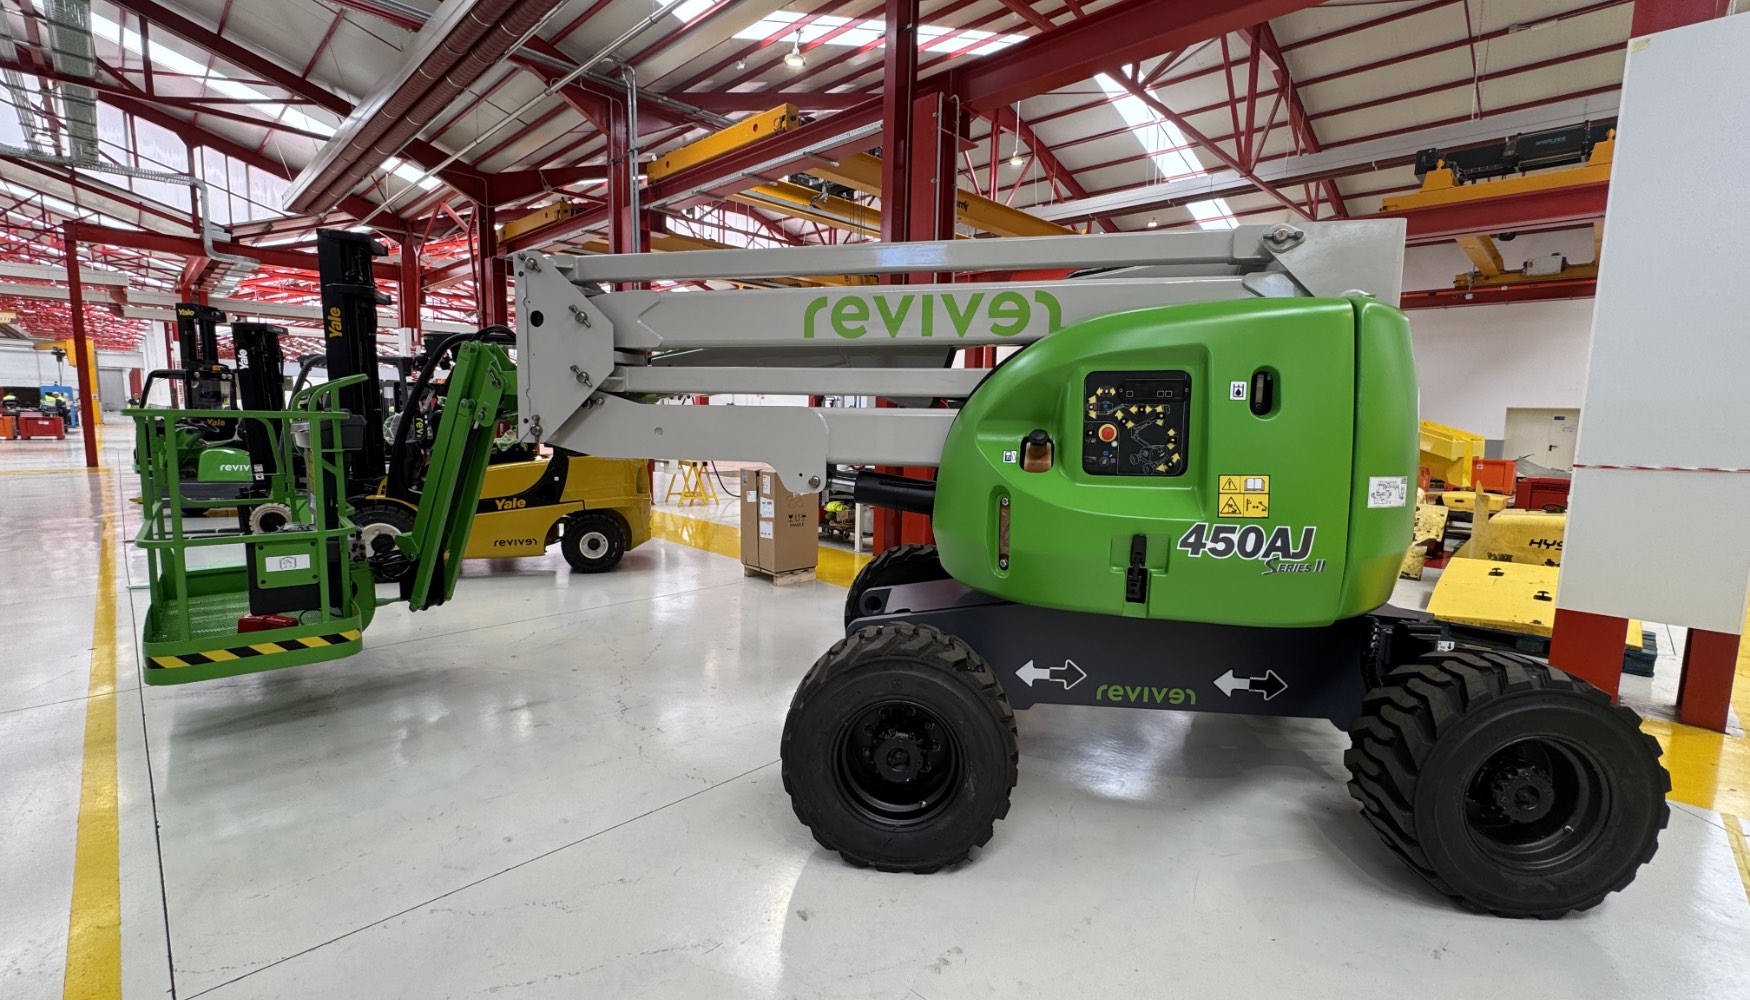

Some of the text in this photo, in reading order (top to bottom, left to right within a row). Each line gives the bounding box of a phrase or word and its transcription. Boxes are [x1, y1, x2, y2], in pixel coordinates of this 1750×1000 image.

[178, 308, 195, 316] Yale
[803, 289, 1064, 339] reviver
[327, 306, 342, 338] Yale
[238, 348, 249, 369] Yale
[206, 418, 226, 427] Yale
[495, 497, 527, 511] Yale
[493, 538, 538, 548] reviver
[1177, 522, 1317, 561] 450AJ
[1313, 559, 1327, 573] II
[1095, 684, 1196, 705] reviver
